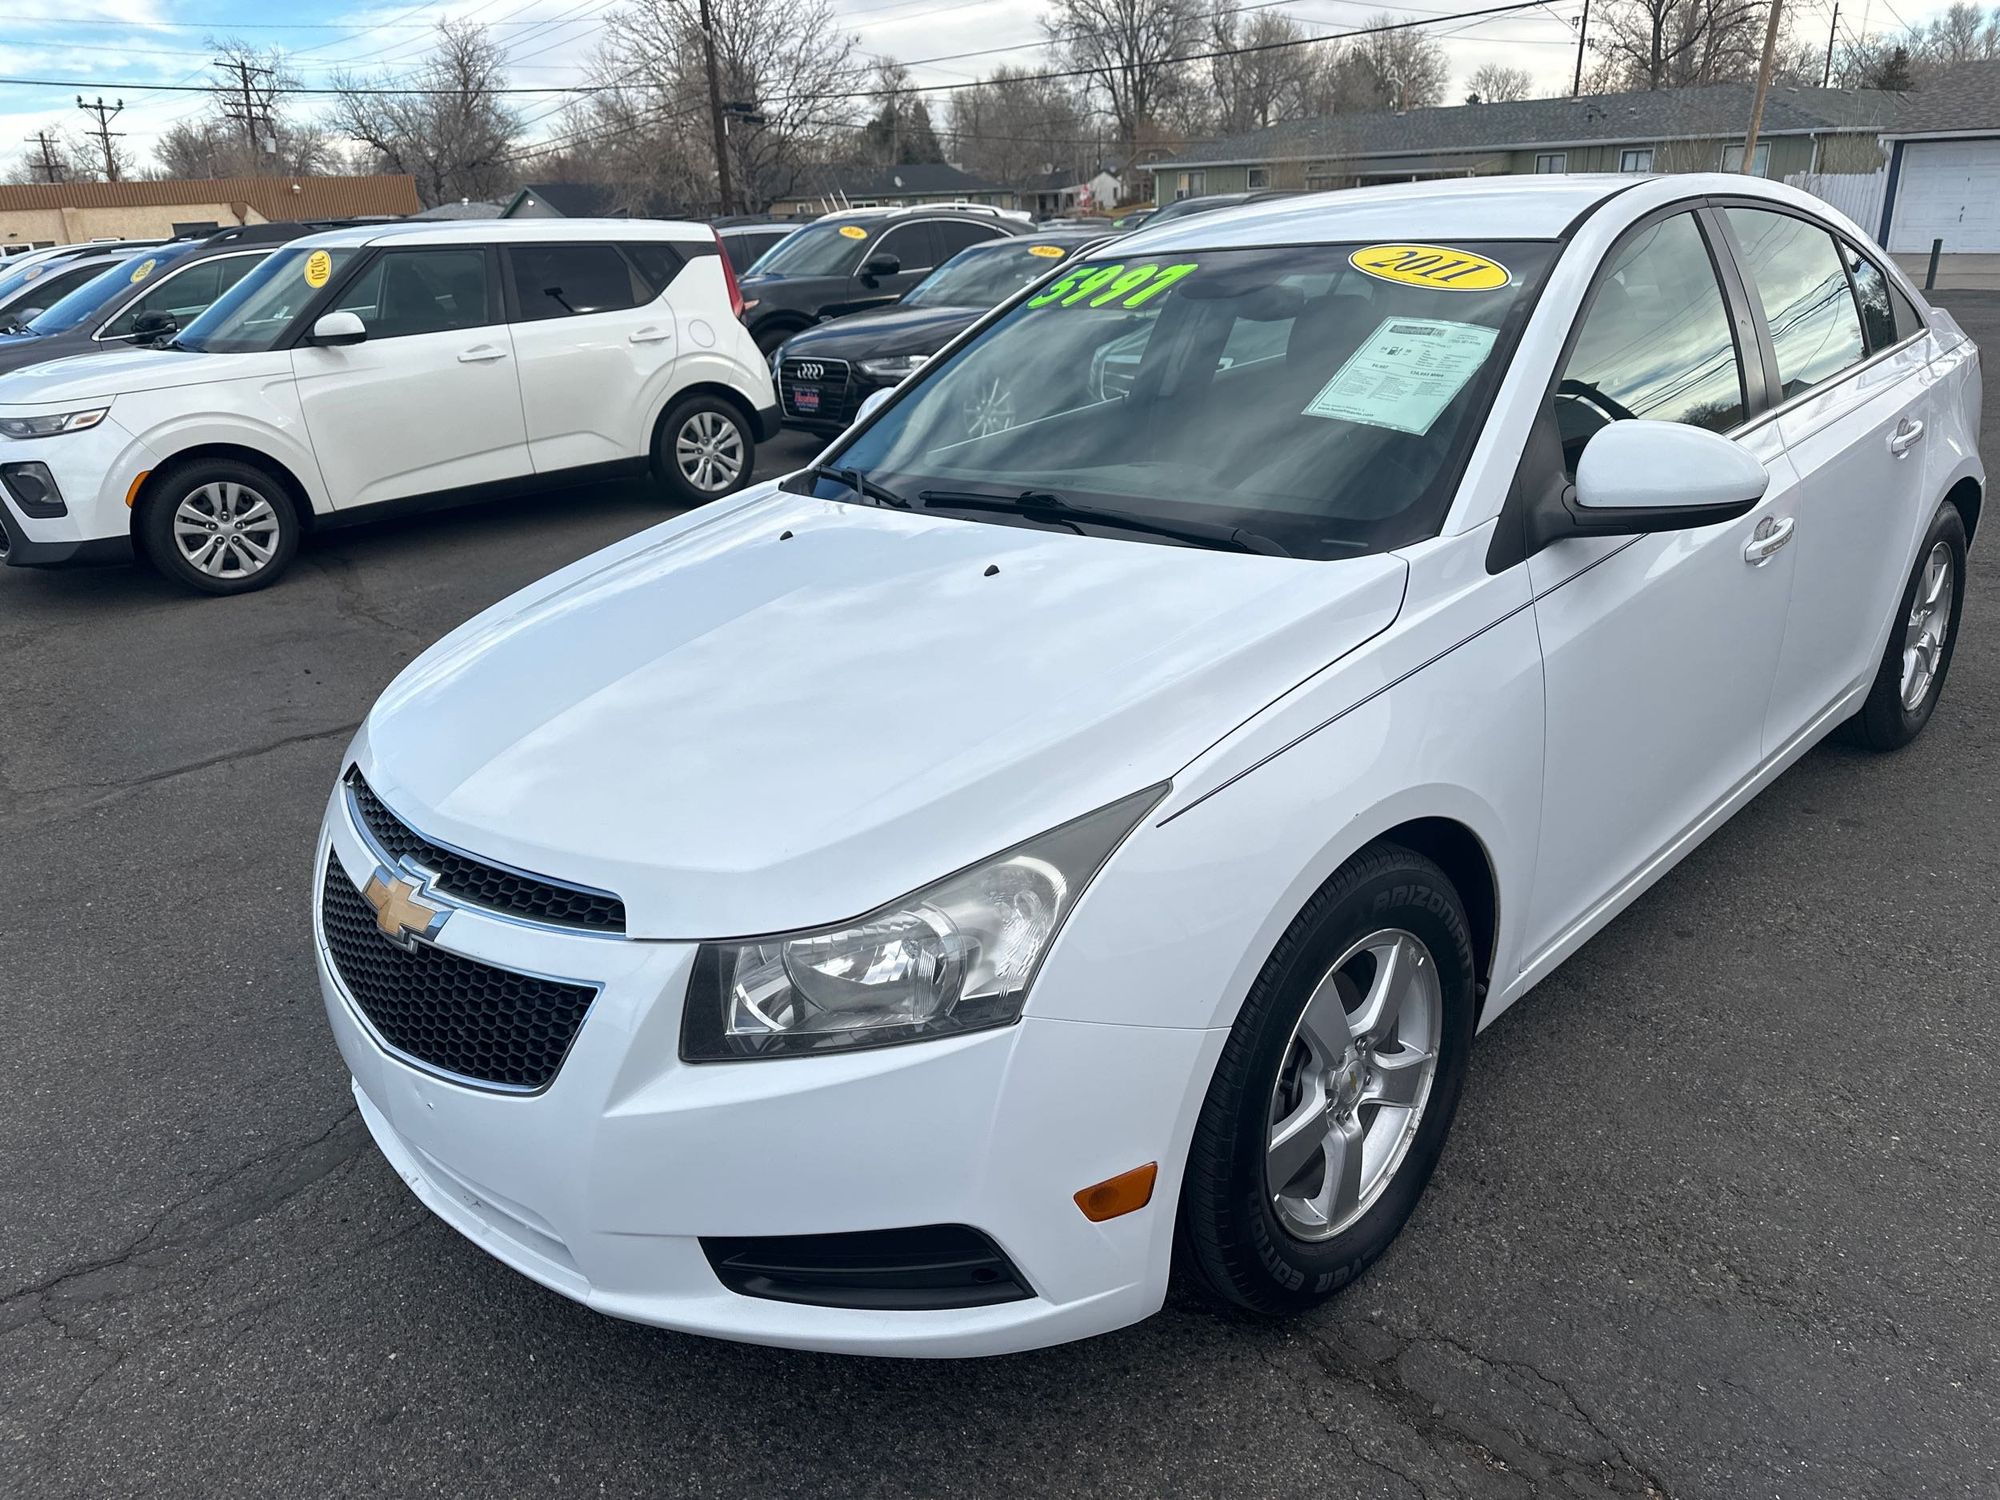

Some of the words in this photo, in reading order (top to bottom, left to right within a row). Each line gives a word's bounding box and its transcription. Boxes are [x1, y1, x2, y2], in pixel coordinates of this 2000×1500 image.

[310, 256, 326, 280] 2020
[1366, 251, 1489, 283] 2011
[1027, 264, 1198, 309] 5997
[1373, 884, 1472, 969] ARIZONIAN
